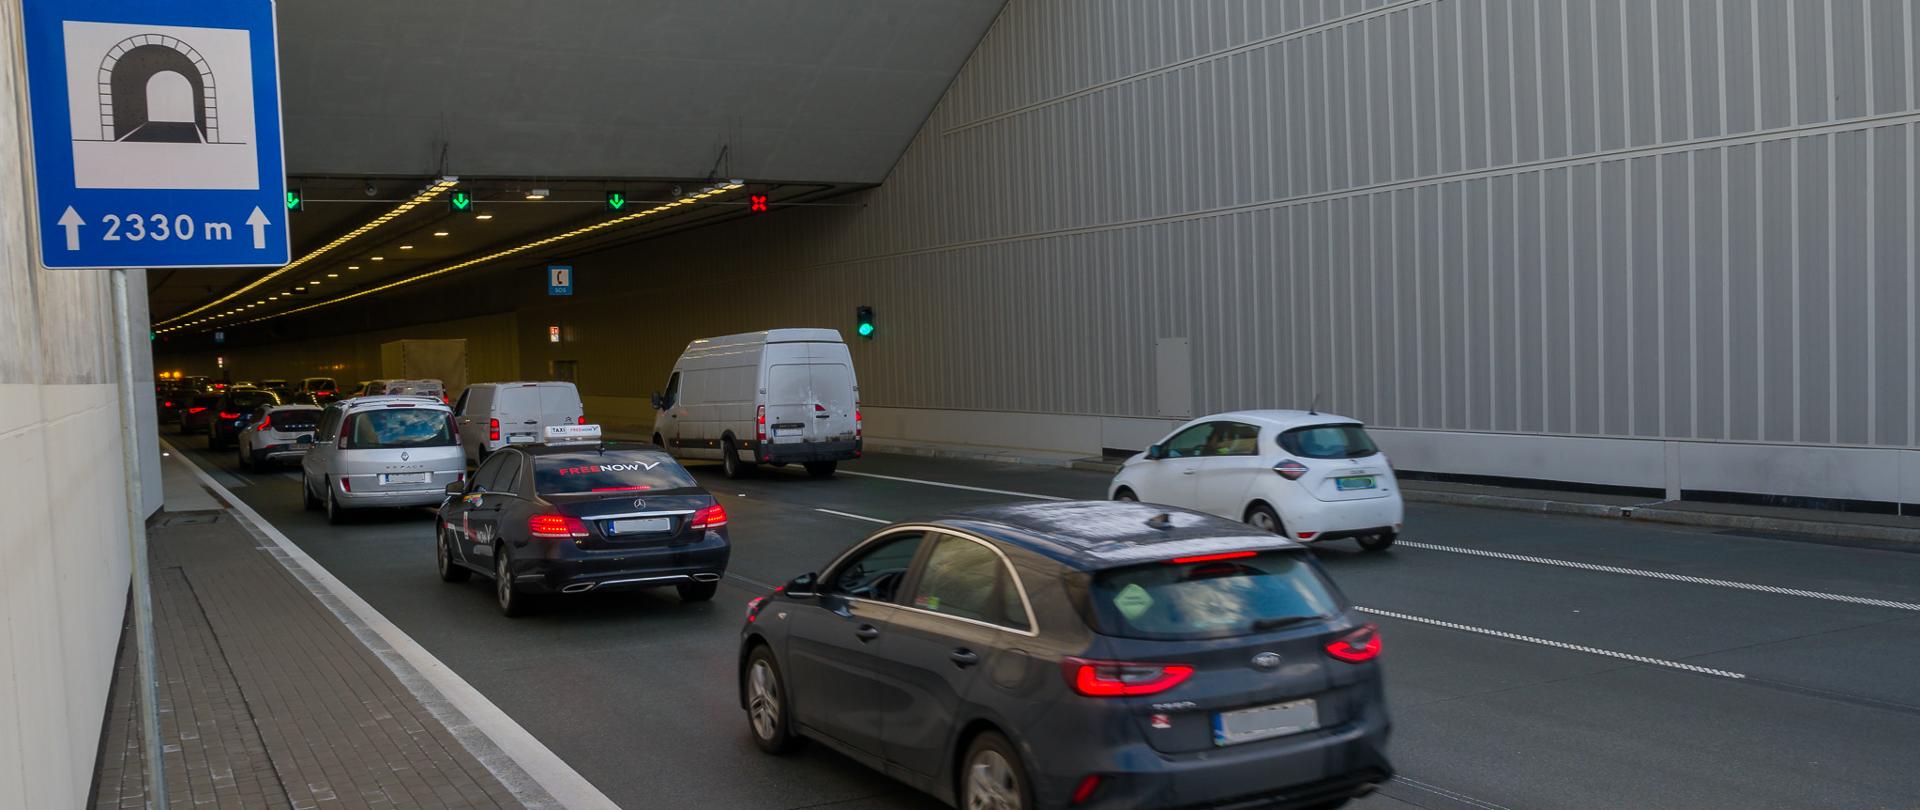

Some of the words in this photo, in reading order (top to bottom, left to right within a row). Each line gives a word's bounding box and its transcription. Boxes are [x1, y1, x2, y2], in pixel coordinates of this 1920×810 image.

[102, 213, 195, 241] 2330
[204, 222, 232, 240] m
[559, 464, 639, 476] FREENOW
